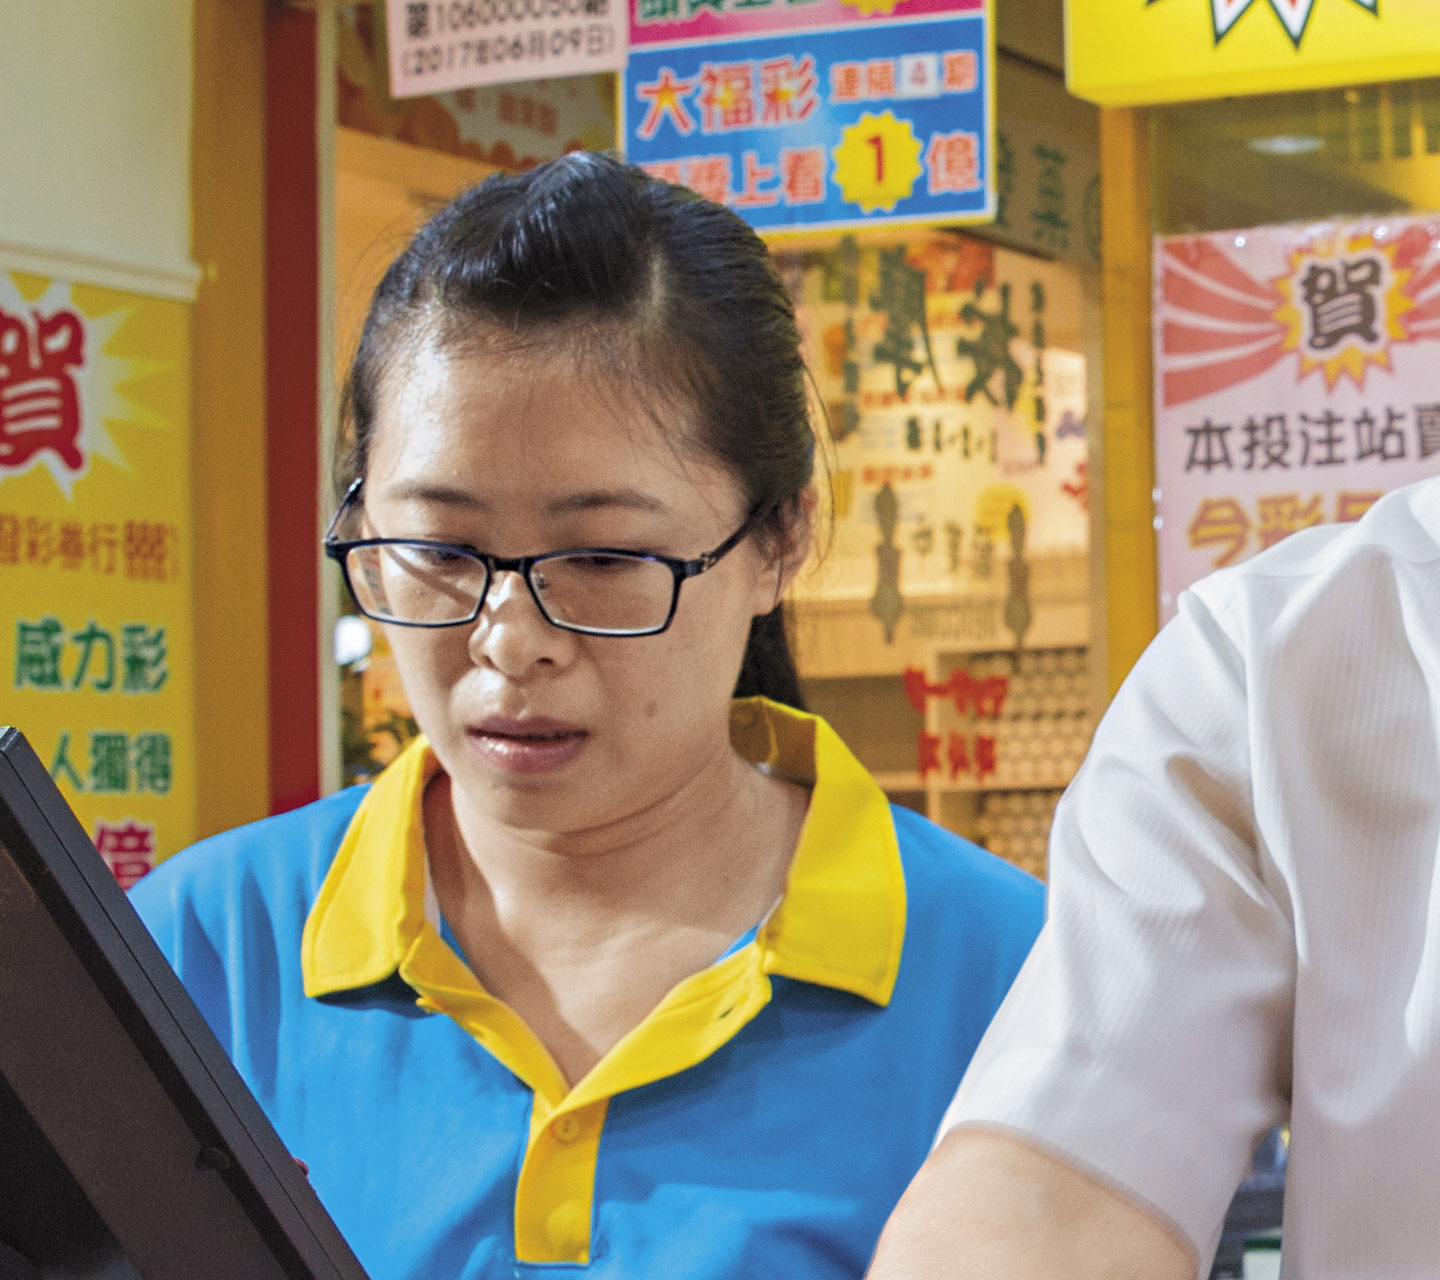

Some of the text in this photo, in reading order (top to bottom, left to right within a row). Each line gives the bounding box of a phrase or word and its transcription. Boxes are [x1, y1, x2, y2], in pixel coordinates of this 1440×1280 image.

[637, 53, 817, 141] 大福彩
[1301, 255, 1384, 352] 賀
[13, 616, 168, 694] 威力彩
